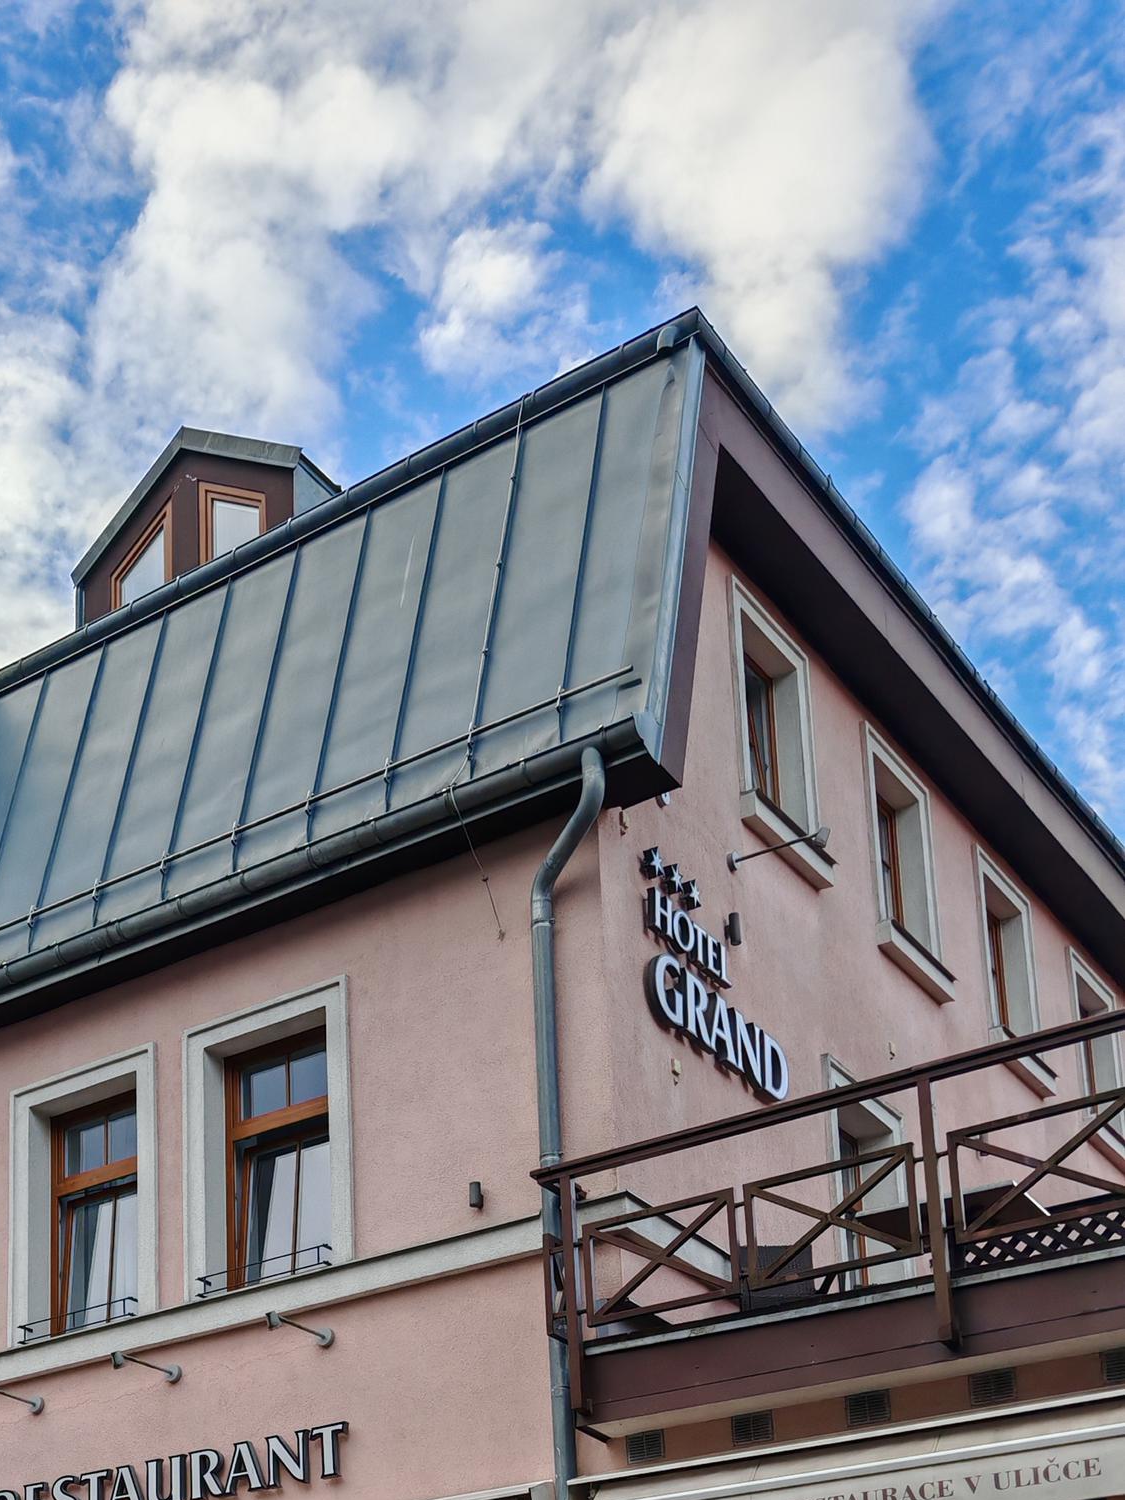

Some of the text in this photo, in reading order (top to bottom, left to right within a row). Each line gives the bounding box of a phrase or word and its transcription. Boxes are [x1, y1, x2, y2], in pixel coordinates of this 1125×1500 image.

[647, 886, 732, 989] HOTEL
[644, 954, 790, 1101] GRAND
[964, 1474, 983, 1495] V
[993, 1457, 1102, 1492] ULIČCE
